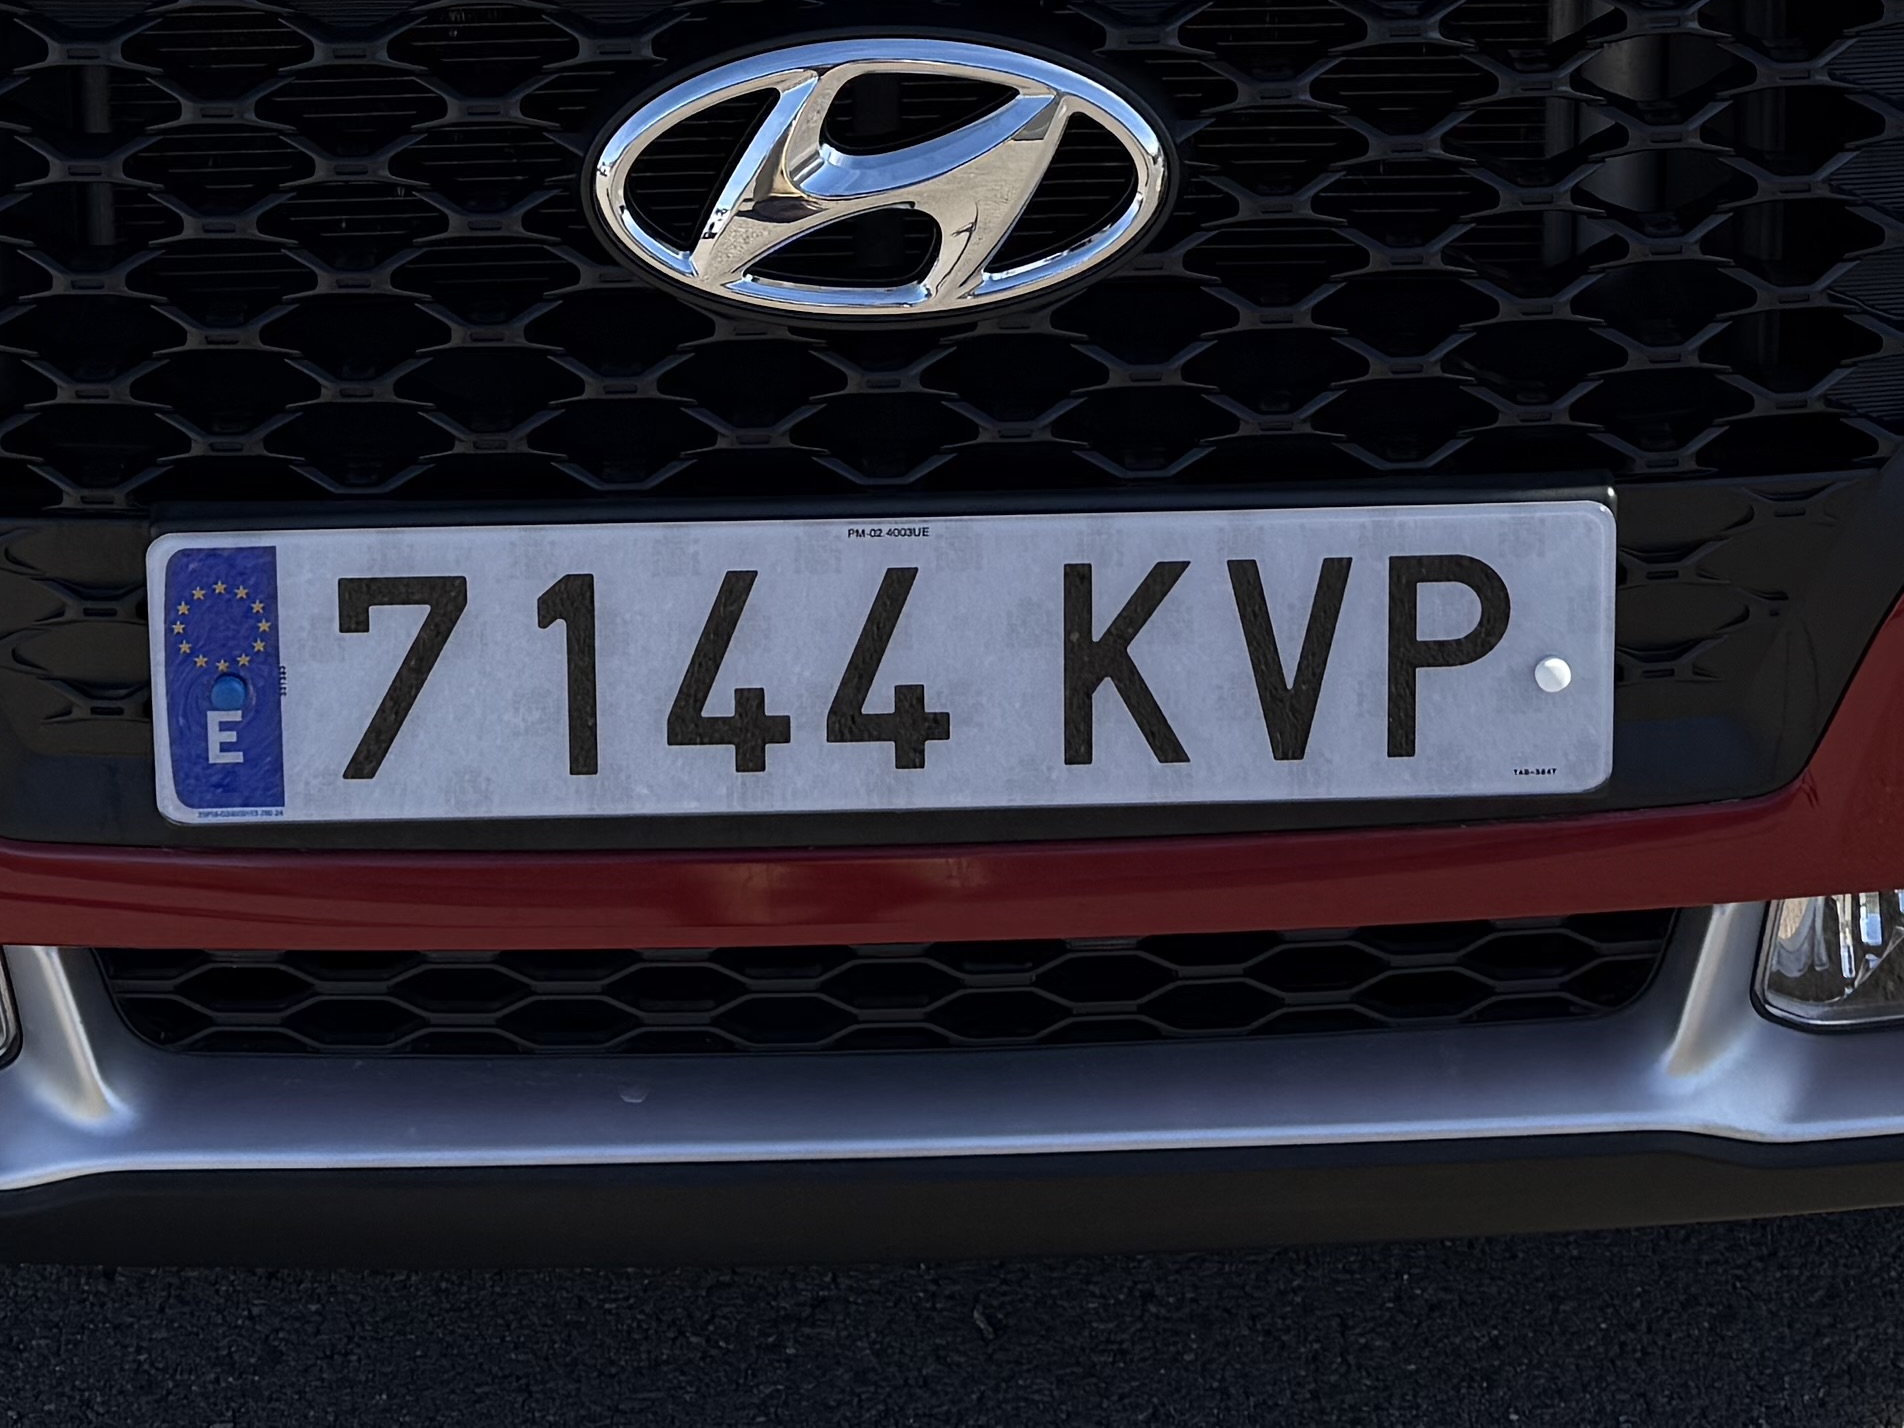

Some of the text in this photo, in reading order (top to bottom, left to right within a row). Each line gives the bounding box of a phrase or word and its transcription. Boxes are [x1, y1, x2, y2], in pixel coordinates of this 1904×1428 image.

[207, 710, 244, 764] E
[337, 554, 1512, 780] 7144 KVP
